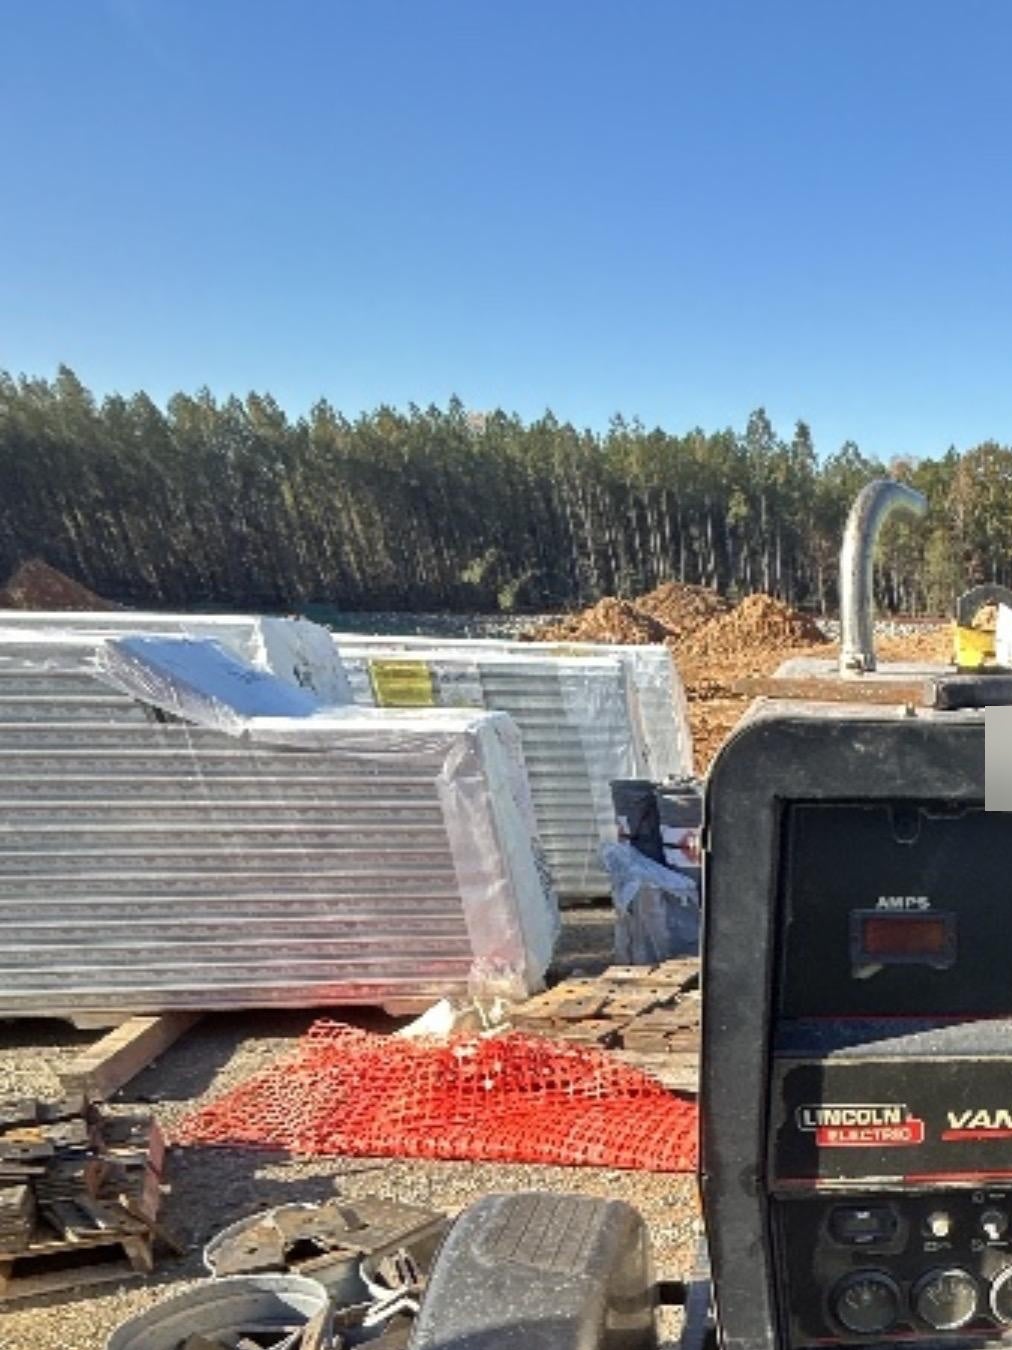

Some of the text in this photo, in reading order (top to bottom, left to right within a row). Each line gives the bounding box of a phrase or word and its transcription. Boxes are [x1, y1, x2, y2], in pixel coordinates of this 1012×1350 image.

[876, 895, 932, 912] AMPS
[802, 1108, 903, 1126] LINCOLN
[827, 1126, 912, 1142] ELECTRIC
